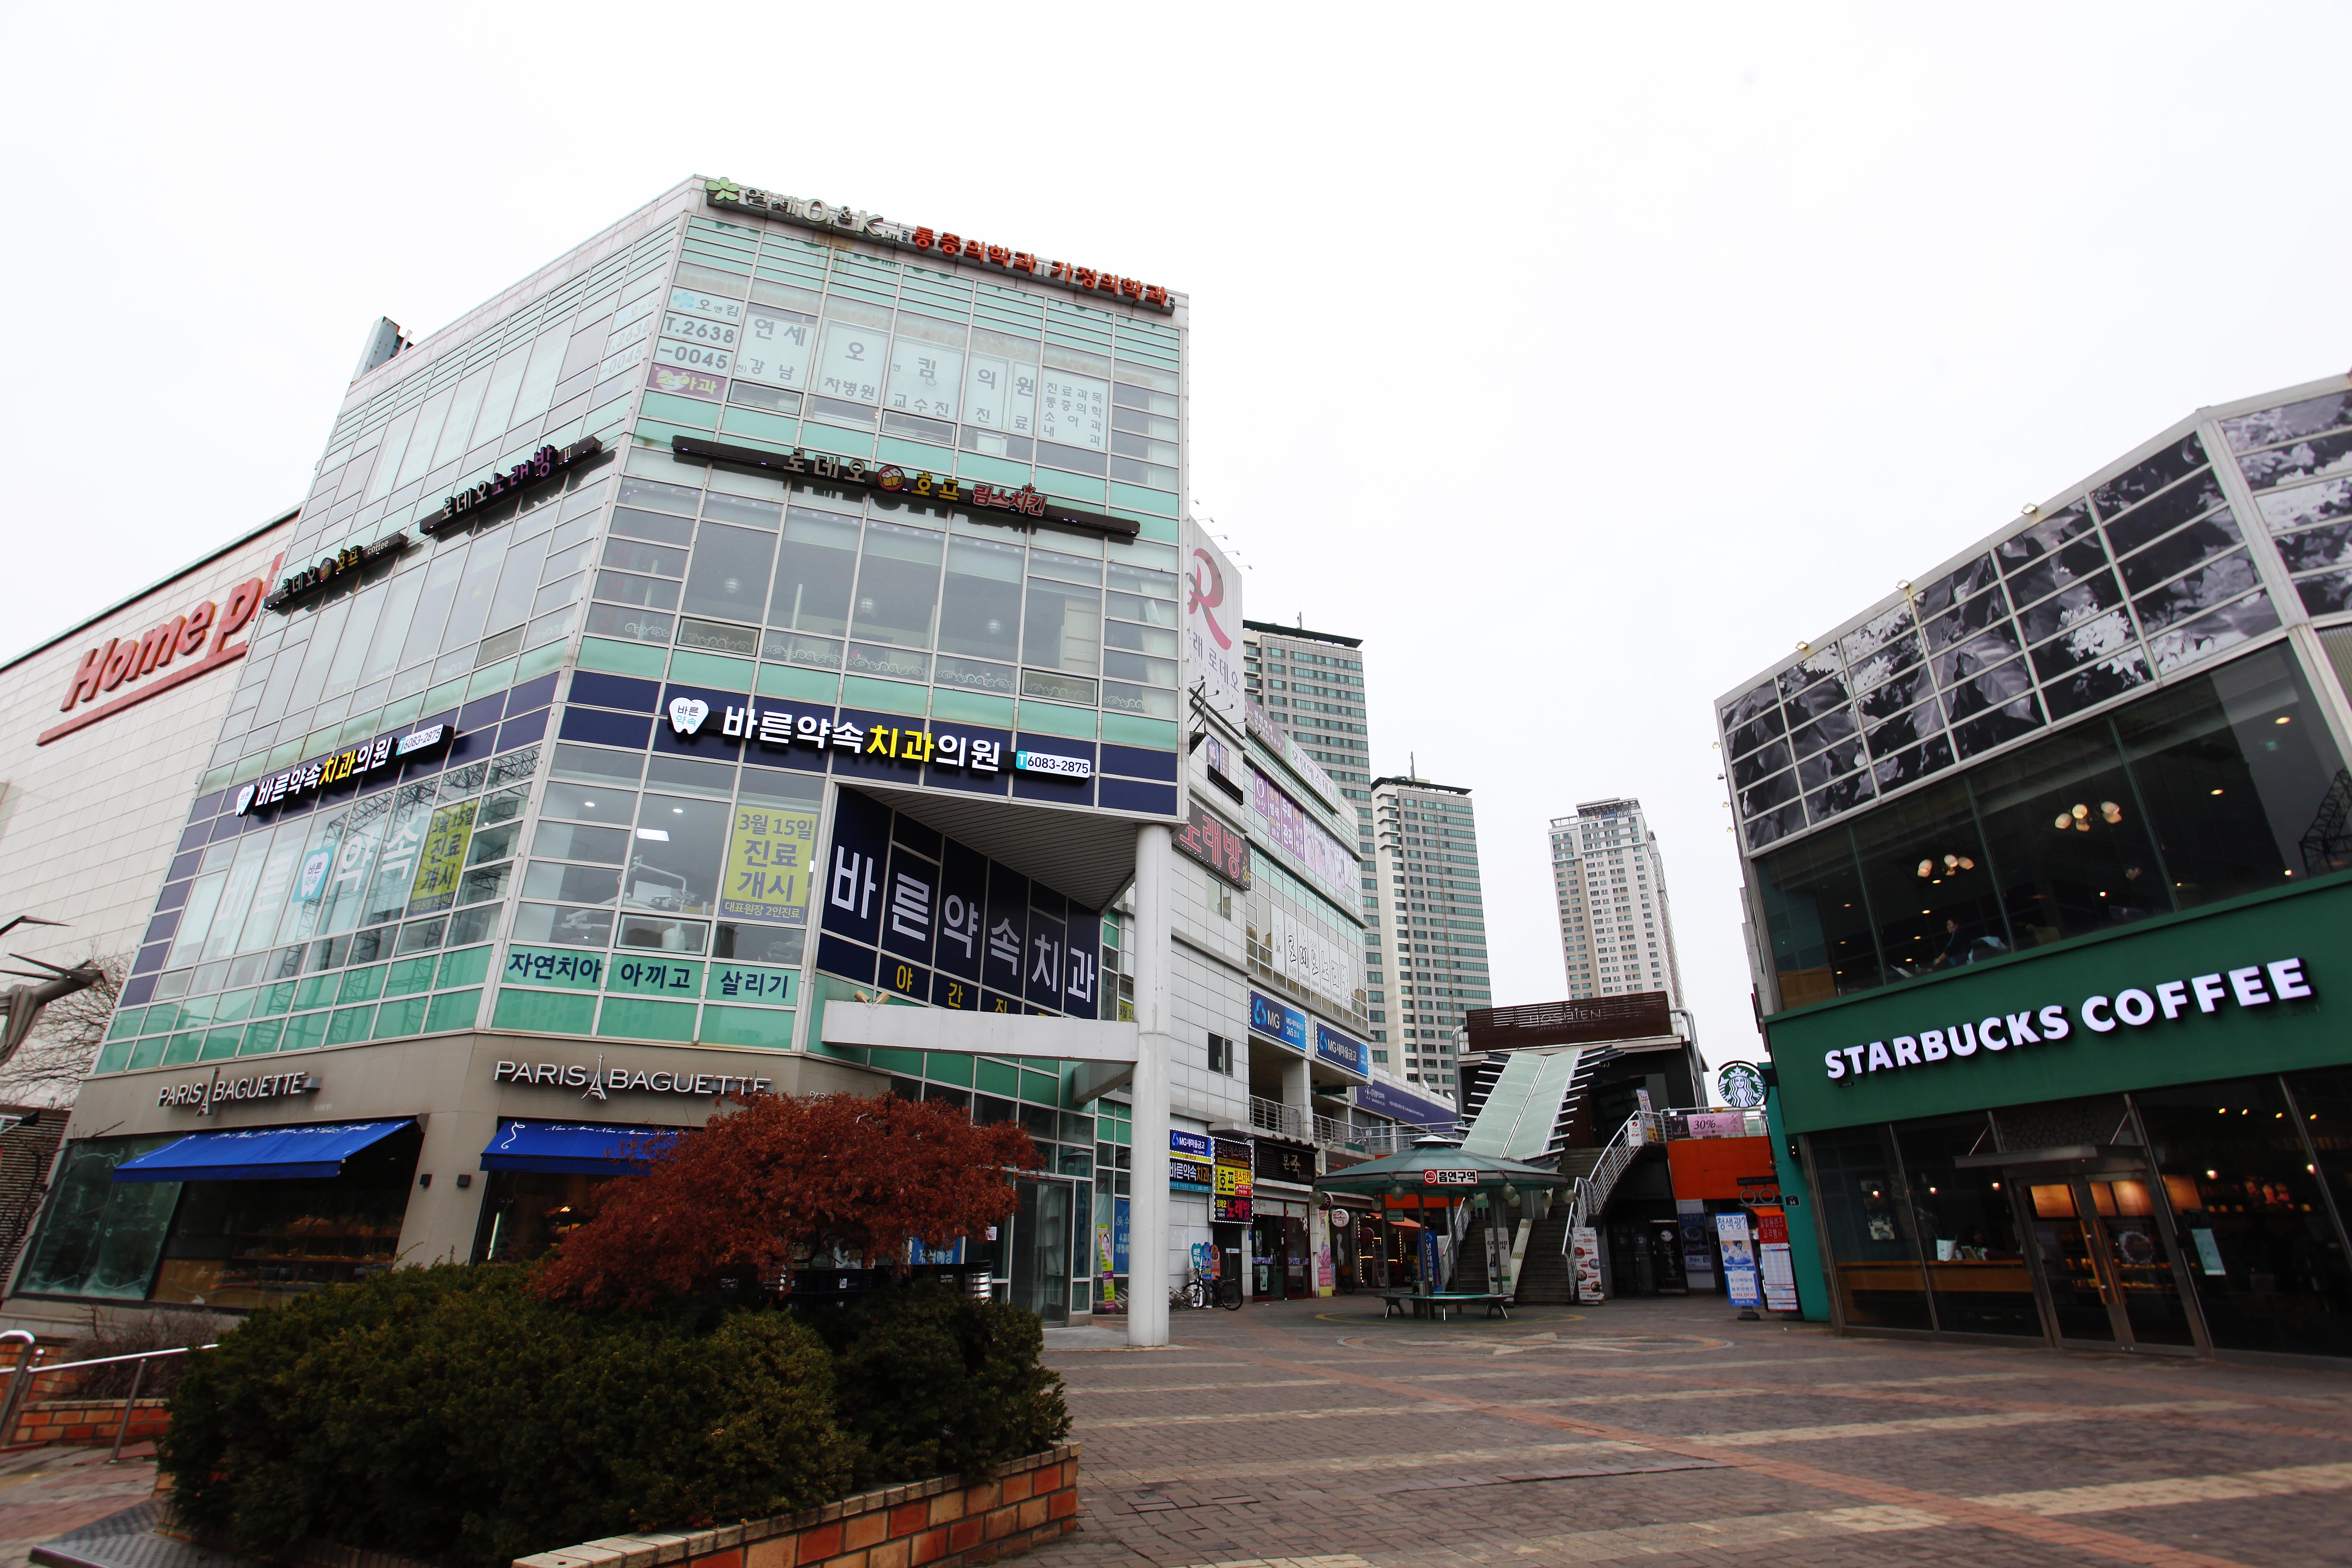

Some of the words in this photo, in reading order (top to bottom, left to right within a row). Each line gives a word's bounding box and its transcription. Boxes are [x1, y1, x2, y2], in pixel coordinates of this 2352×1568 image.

[745, 187, 798, 216] 연세
[912, 225, 1037, 277] 통증의학과
[1050, 260, 1168, 309] 가정의학과
[754, 318, 807, 347] 연세
[656, 372, 717, 395] 소아과
[825, 376, 875, 401] 차병원
[894, 392, 949, 418] 교수진
[1047, 382, 1102, 404] 진료과목
[783, 448, 866, 483] 로데오
[917, 470, 959, 501] 호프
[972, 483, 1048, 516] 림스치킨
[281, 567, 316, 599] 로데오
[336, 545, 359, 573] 호프
[367, 539, 389, 555] coffee
[60, 600, 216, 712] Home
[1209, 647, 1240, 693] 로데오
[675, 714, 697, 727] 약속
[677, 705, 699, 716] 바른
[723, 706, 1000, 772] 바른약속치과의원
[255, 737, 393, 807] 바른약속치과의원
[1292, 749, 1336, 802] 모던에스테틱
[1282, 797, 1292, 824] 두피
[738, 813, 769, 836] 3월
[772, 818, 813, 841] 15일
[1283, 823, 1293, 849] 관리
[337, 822, 420, 891] 약속
[743, 839, 799, 868] 진료
[1179, 814, 1242, 879] 노래방
[307, 861, 322, 875] 바른
[736, 871, 794, 902] 개시
[724, 901, 763, 916] 대표원장
[765, 906, 800, 919] 2인진료
[831, 845, 1095, 1003] 바른약속치과
[508, 952, 602, 983] 자연치아
[620, 963, 691, 988] 아끼고
[720, 970, 789, 999] 살리기
[1267, 1010, 1280, 1029] MG
[1825, 1004, 2070, 1079] STARBUCKS
[2081, 957, 2313, 1033] COFFEE
[1328, 1038, 1357, 1062] MG새마을금고
[157, 1082, 204, 1107] PARIS
[212, 1071, 307, 1102] BAGUETTE
[494, 1060, 586, 1086] PARIS
[608, 1068, 771, 1096] BAGUETTE
[1694, 1119, 1716, 1130] 30%
[1179, 1137, 1205, 1149] MG새마을금고
[1219, 1169, 1235, 1191] 호프
[1234, 1170, 1251, 1184] 림스치킨
[1283, 1153, 1301, 1179] 본죽
[1439, 1171, 1476, 1183] 흡연구역
[1216, 1199, 1227, 1208] 로데오
[1226, 1199, 1251, 1220] 노래방
[1717, 1217, 1747, 1230] 청색광?
